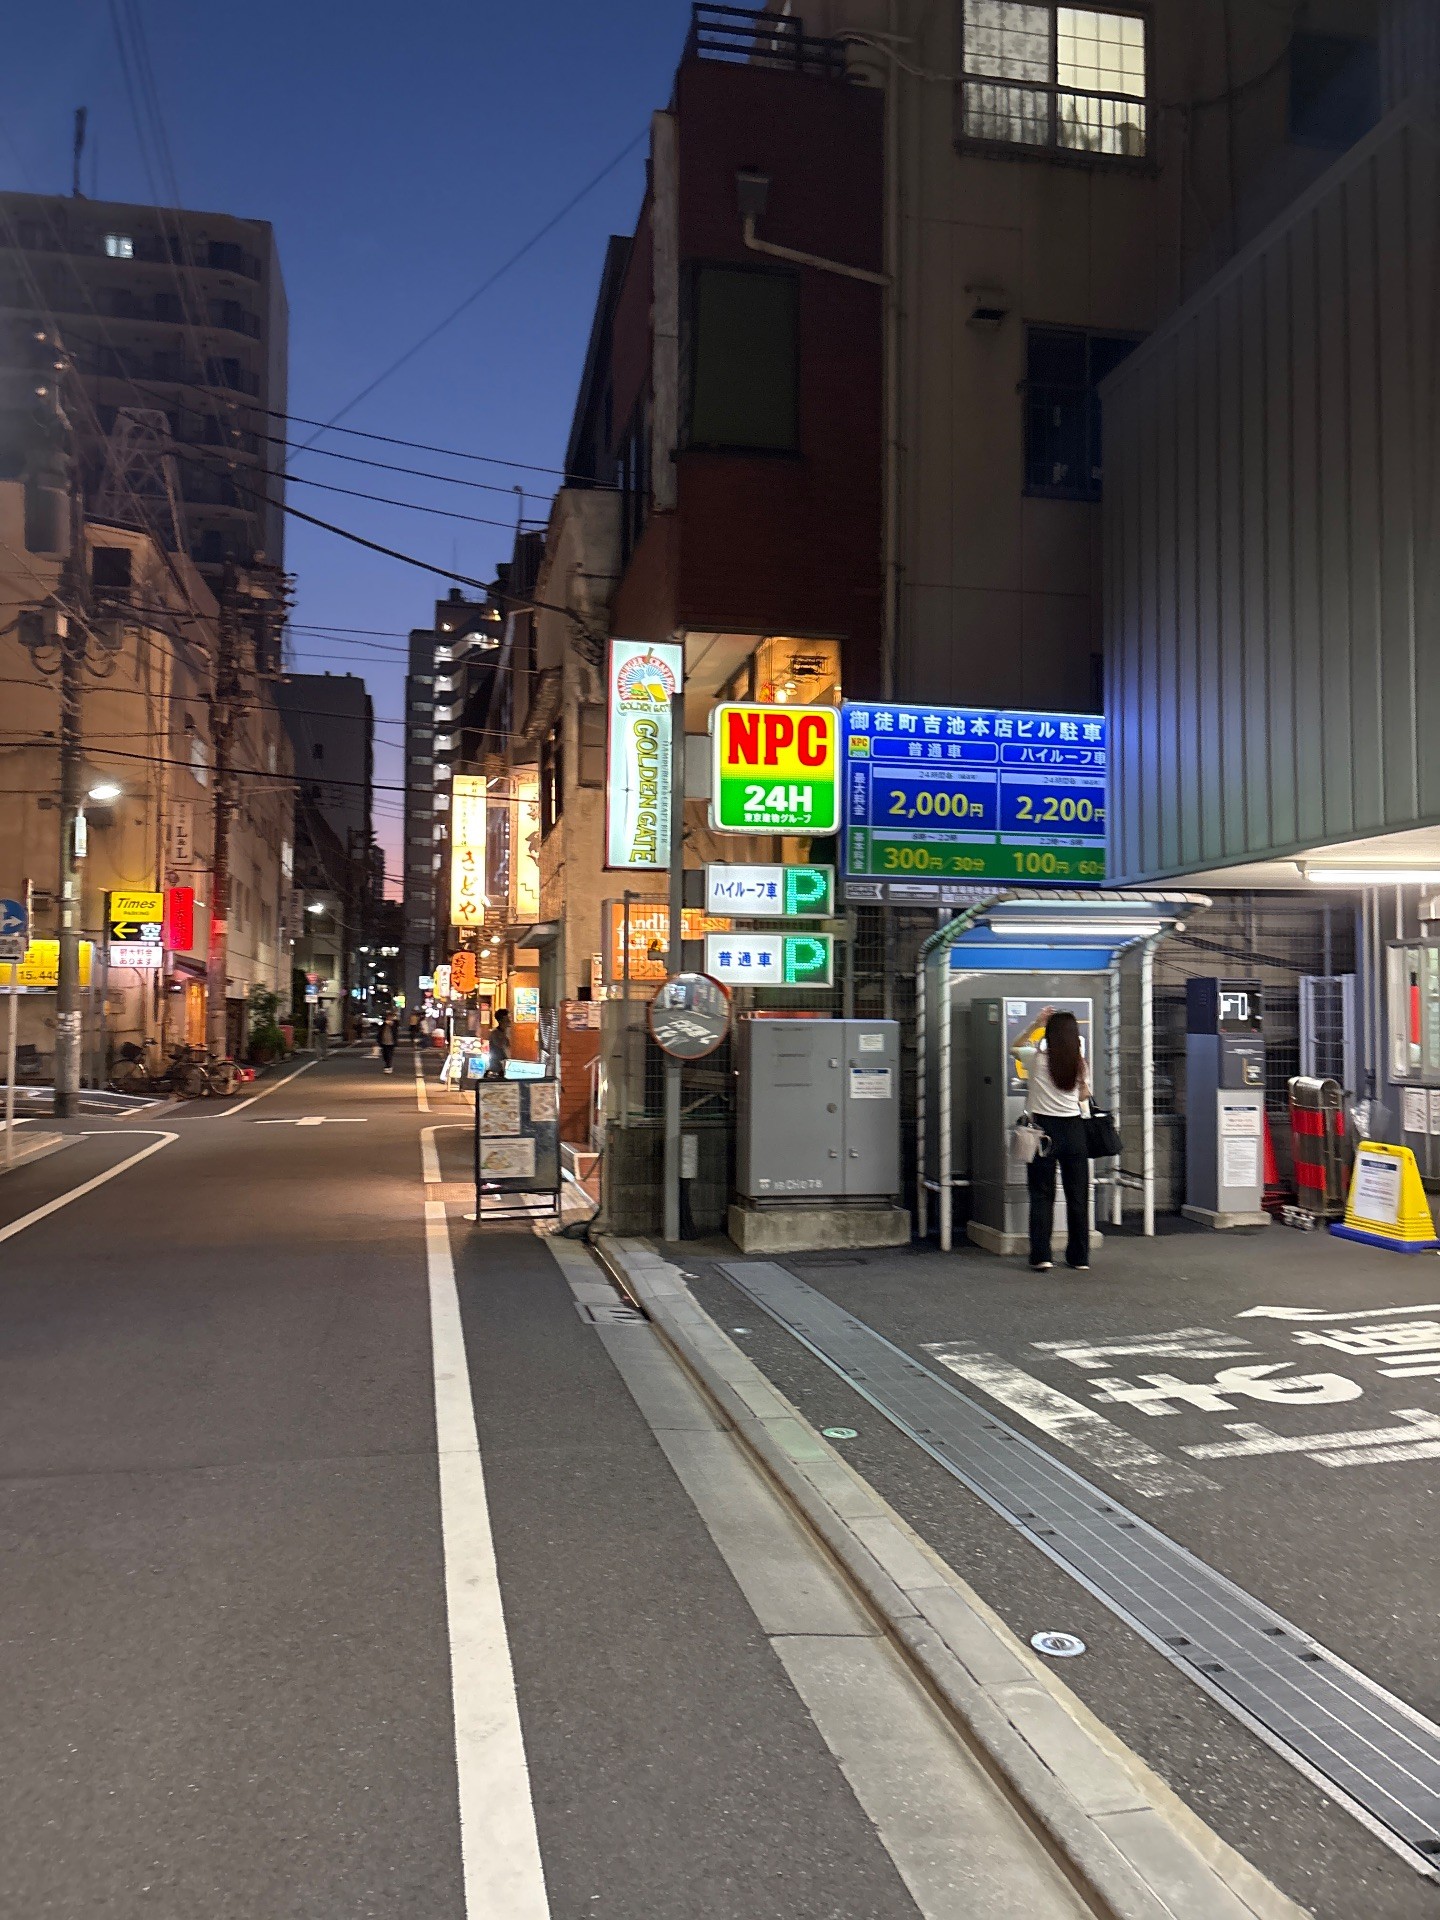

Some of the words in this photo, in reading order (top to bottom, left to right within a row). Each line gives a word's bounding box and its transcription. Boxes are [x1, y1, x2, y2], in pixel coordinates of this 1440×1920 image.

[728, 712, 827, 767] NPC
[851, 737, 868, 747] NPC
[908, 742, 962, 758] 普通車
[1020, 747, 1106, 766] ハイルーフ車
[633, 718, 660, 809] GOLDEN
[743, 785, 813, 812] 24H
[888, 790, 984, 818] 2,000円
[744, 813, 812, 824] 東京建物グループ
[629, 811, 658, 863] GATE
[714, 881, 778, 899] ハイルーフ車
[786, 868, 827, 916] P
[117, 898, 157, 909] Times
[140, 922, 162, 941] 空
[616, 913, 690, 931] Andha
[718, 951, 773, 968] 普通車
[785, 938, 826, 984] P
